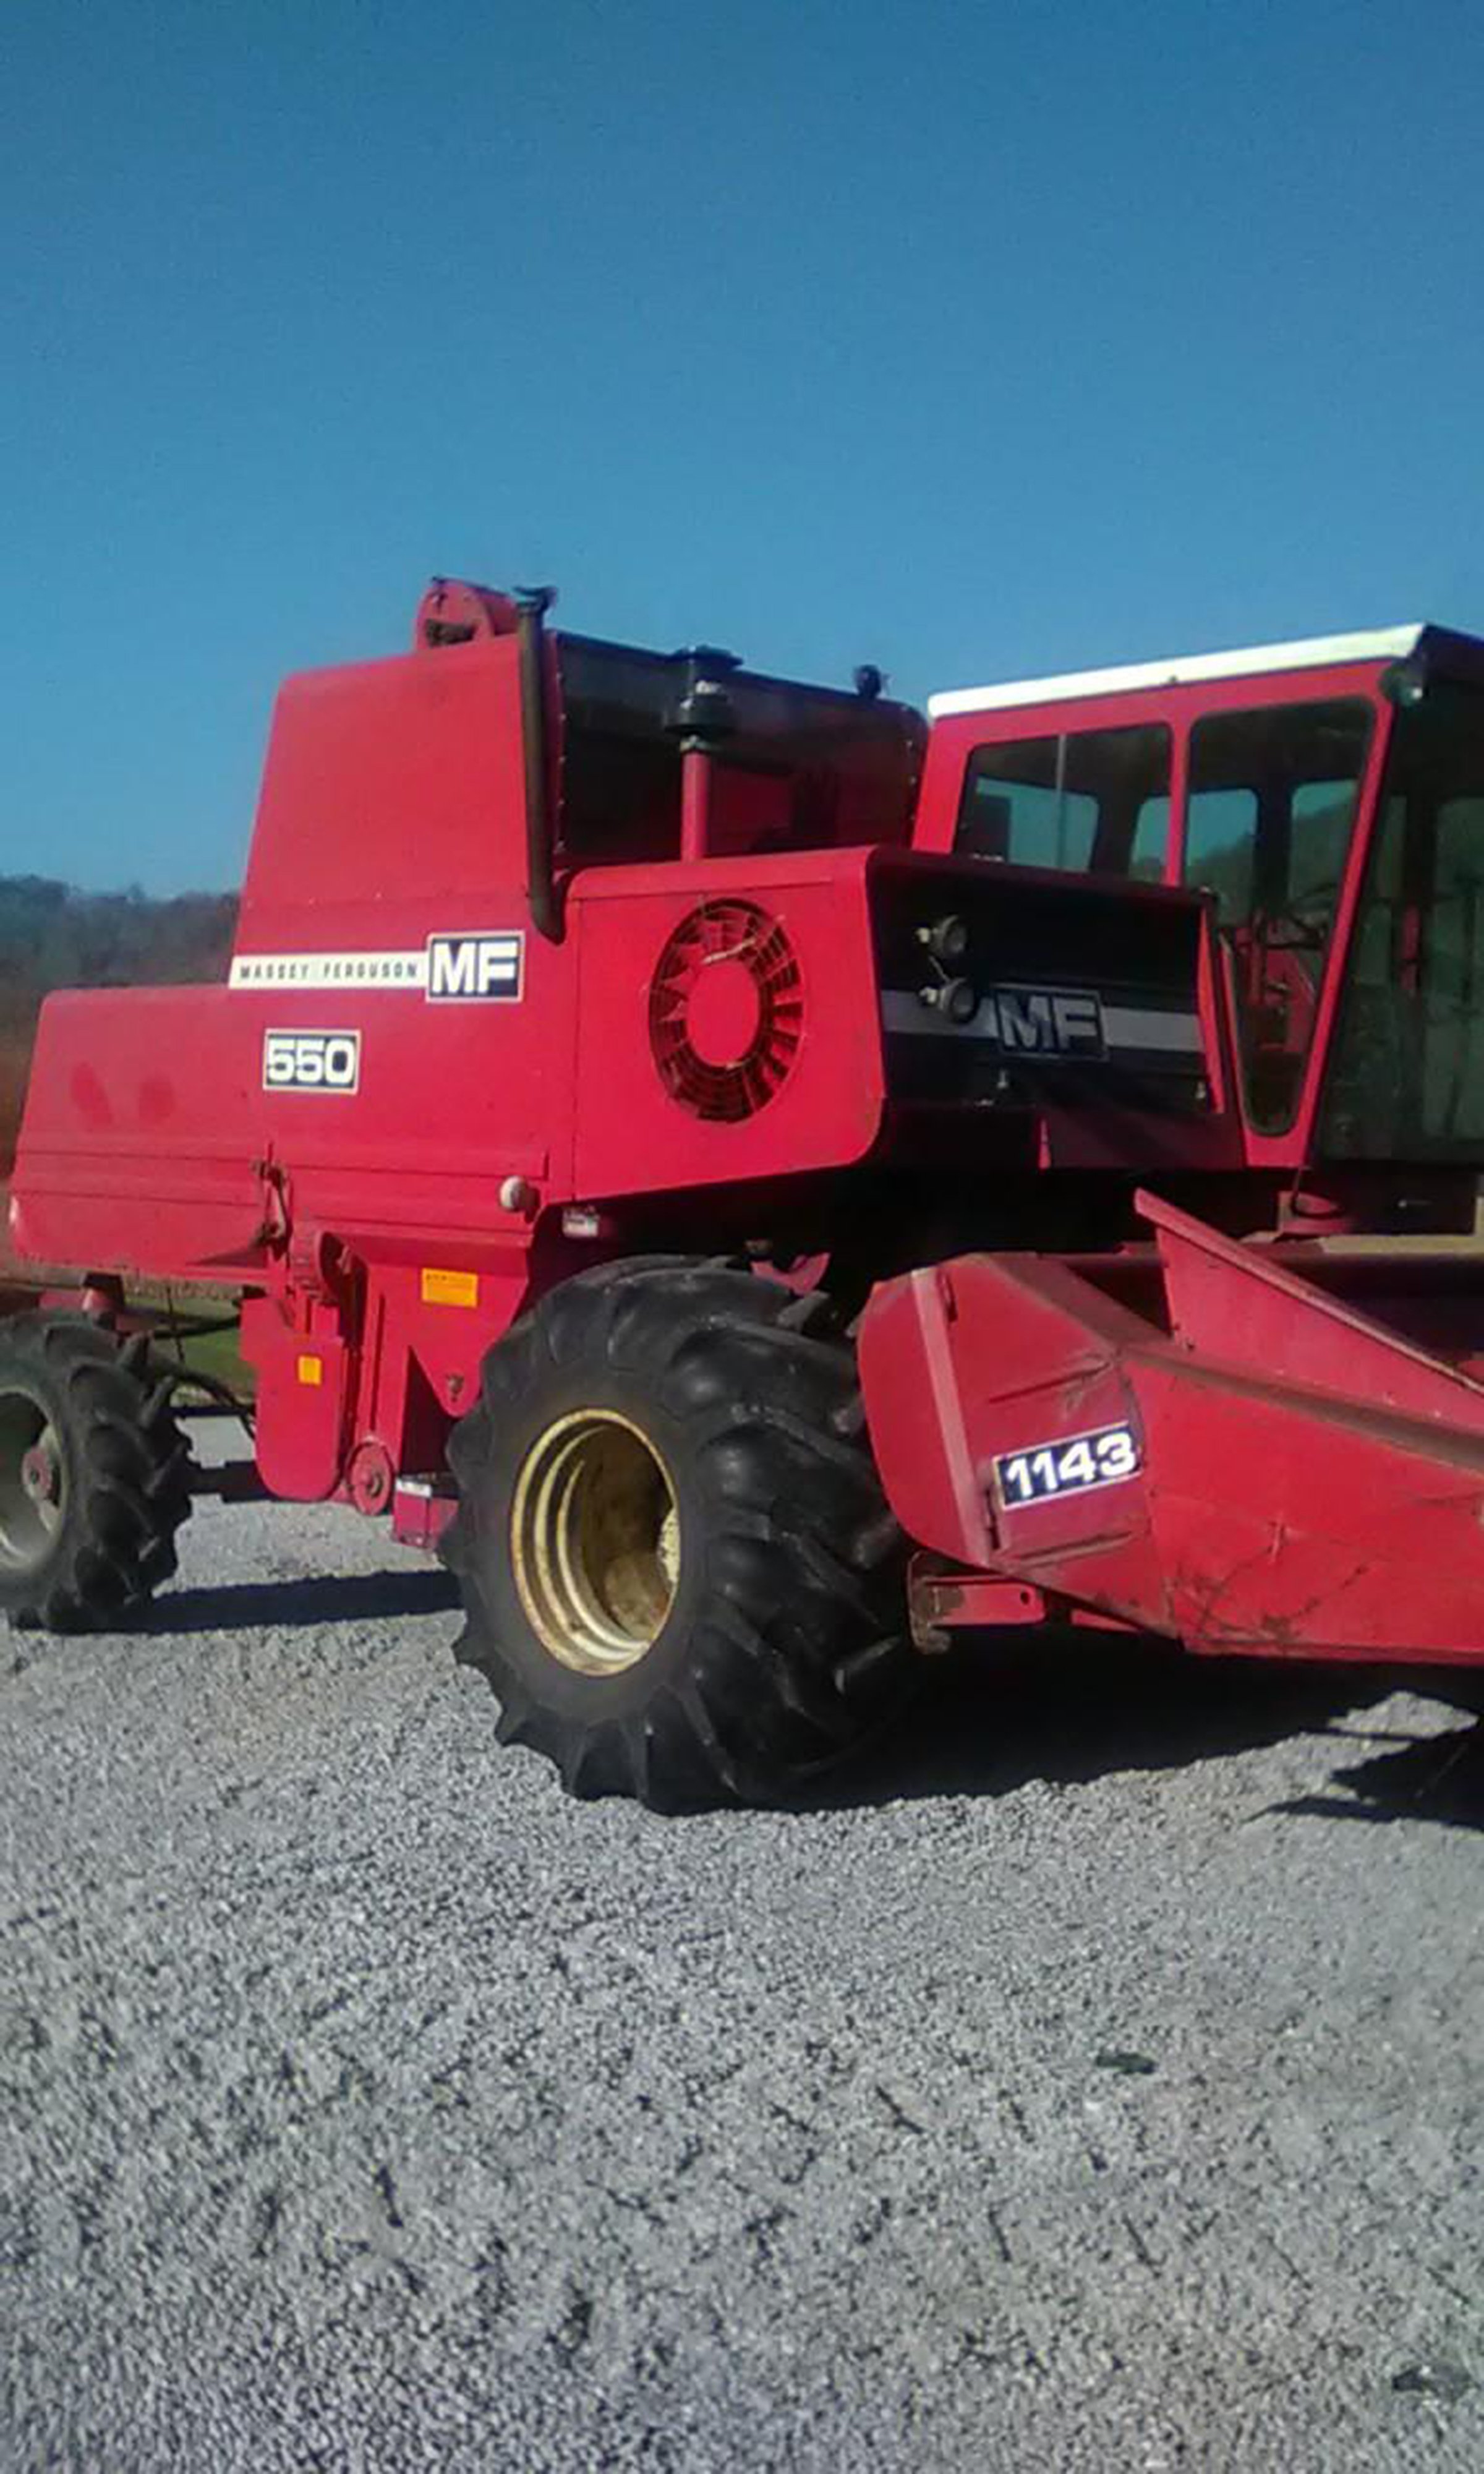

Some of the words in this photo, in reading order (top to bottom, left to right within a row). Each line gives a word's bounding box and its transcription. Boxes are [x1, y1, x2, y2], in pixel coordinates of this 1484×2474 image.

[323, 962, 417, 977] FERGUSON
[432, 941, 518, 993] MF
[998, 994, 1098, 1048] MF
[267, 1038, 355, 1083] 550
[1006, 1432, 1136, 1497] 1143
